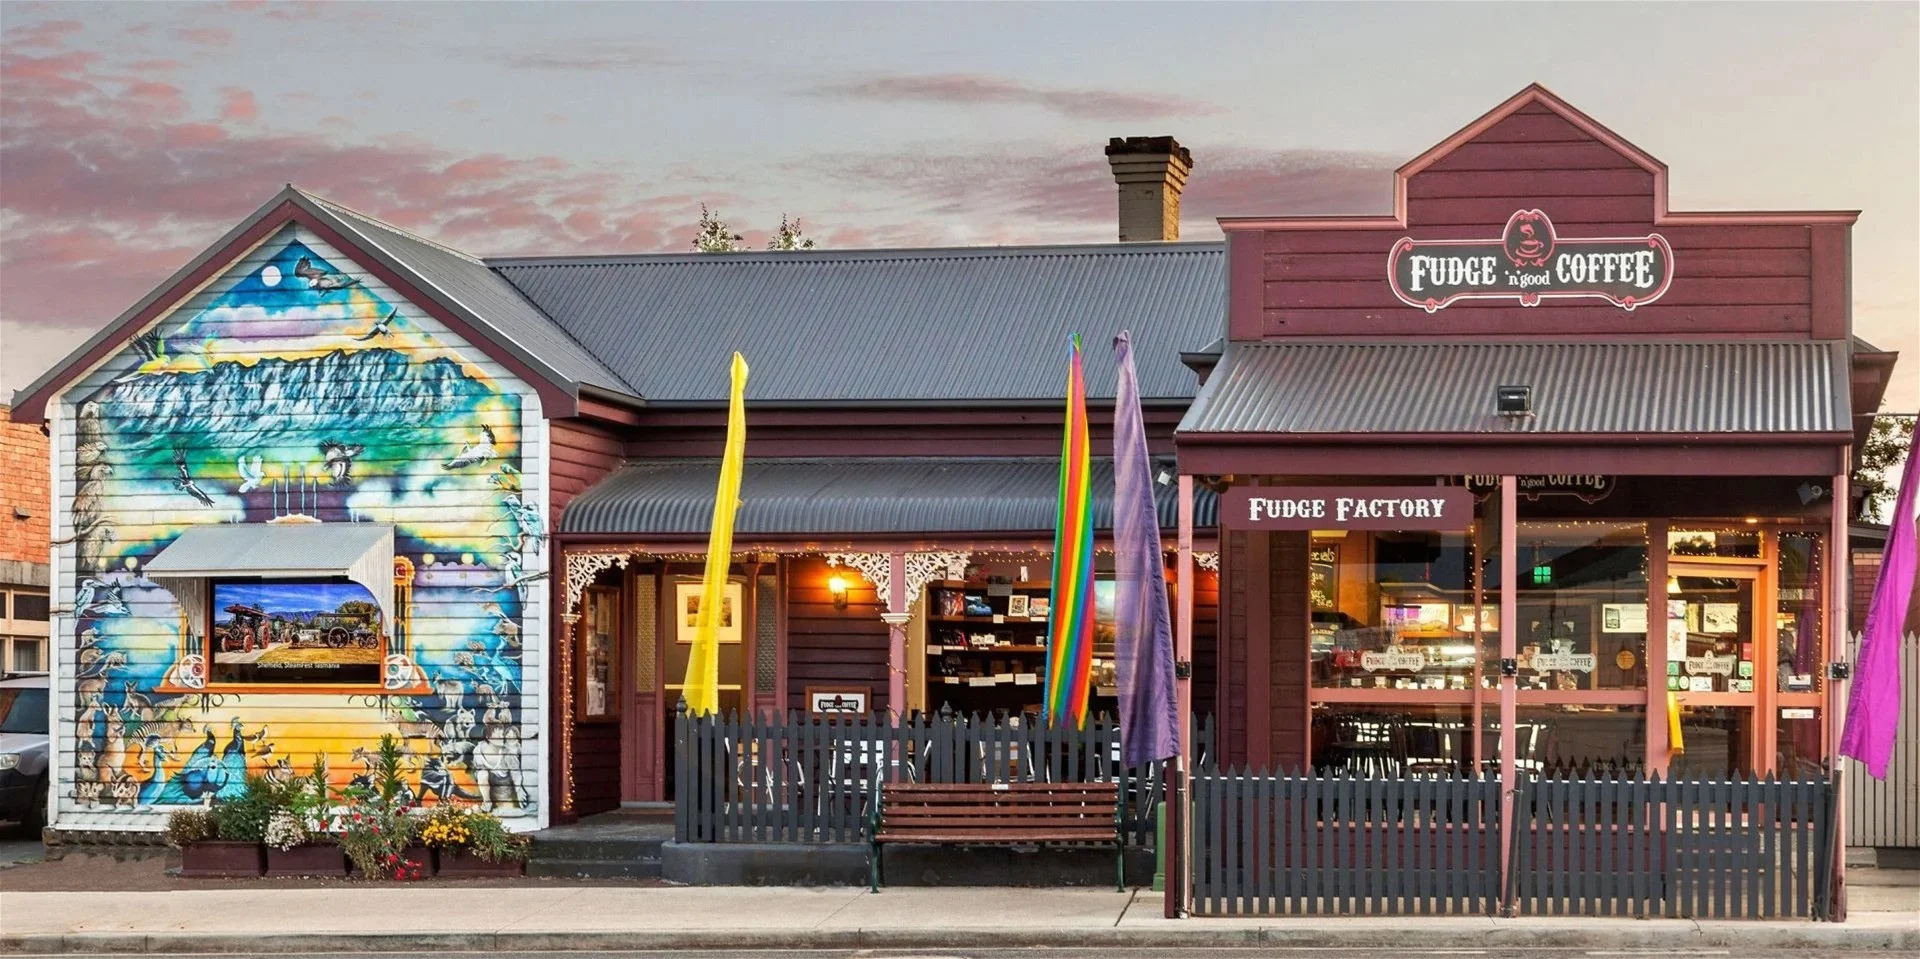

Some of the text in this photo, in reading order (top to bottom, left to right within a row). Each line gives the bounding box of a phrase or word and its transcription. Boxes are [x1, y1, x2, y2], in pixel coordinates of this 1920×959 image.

[1409, 255, 1497, 291] FUDGE
[1555, 251, 1654, 288] COFFEE
[1249, 498, 1446, 521] FUDGE FACTORY
